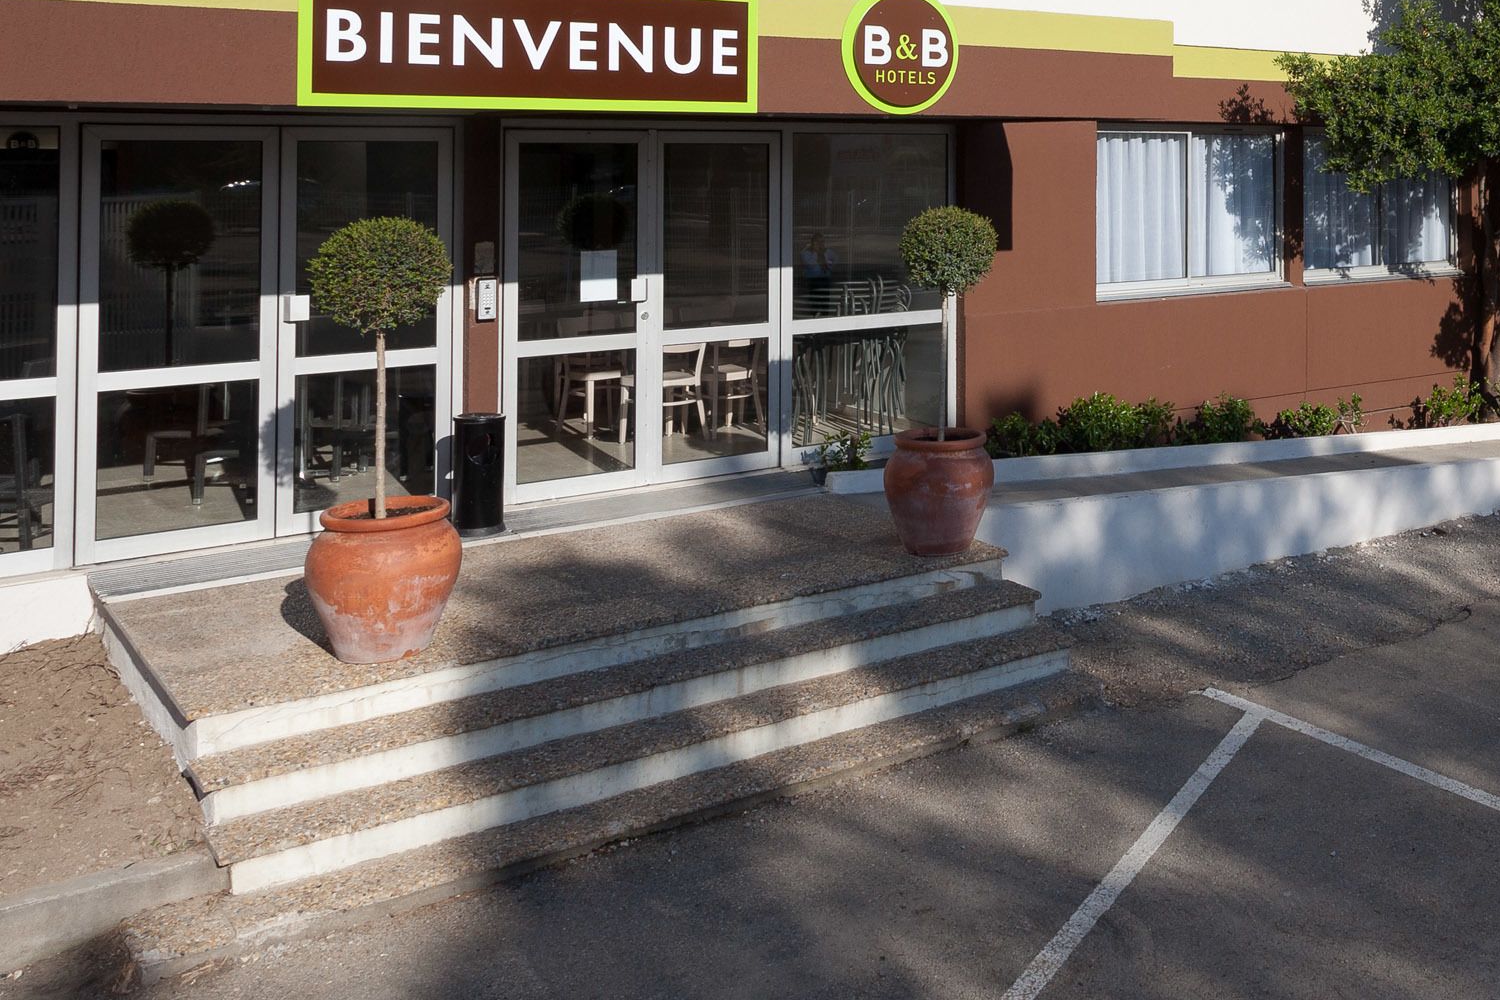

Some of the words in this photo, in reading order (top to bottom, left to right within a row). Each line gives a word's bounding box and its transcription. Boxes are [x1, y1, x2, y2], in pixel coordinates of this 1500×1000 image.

[325, 8, 738, 75] BIENVENUE
[864, 24, 949, 68] B&B
[875, 69, 936, 85] HOTELS
